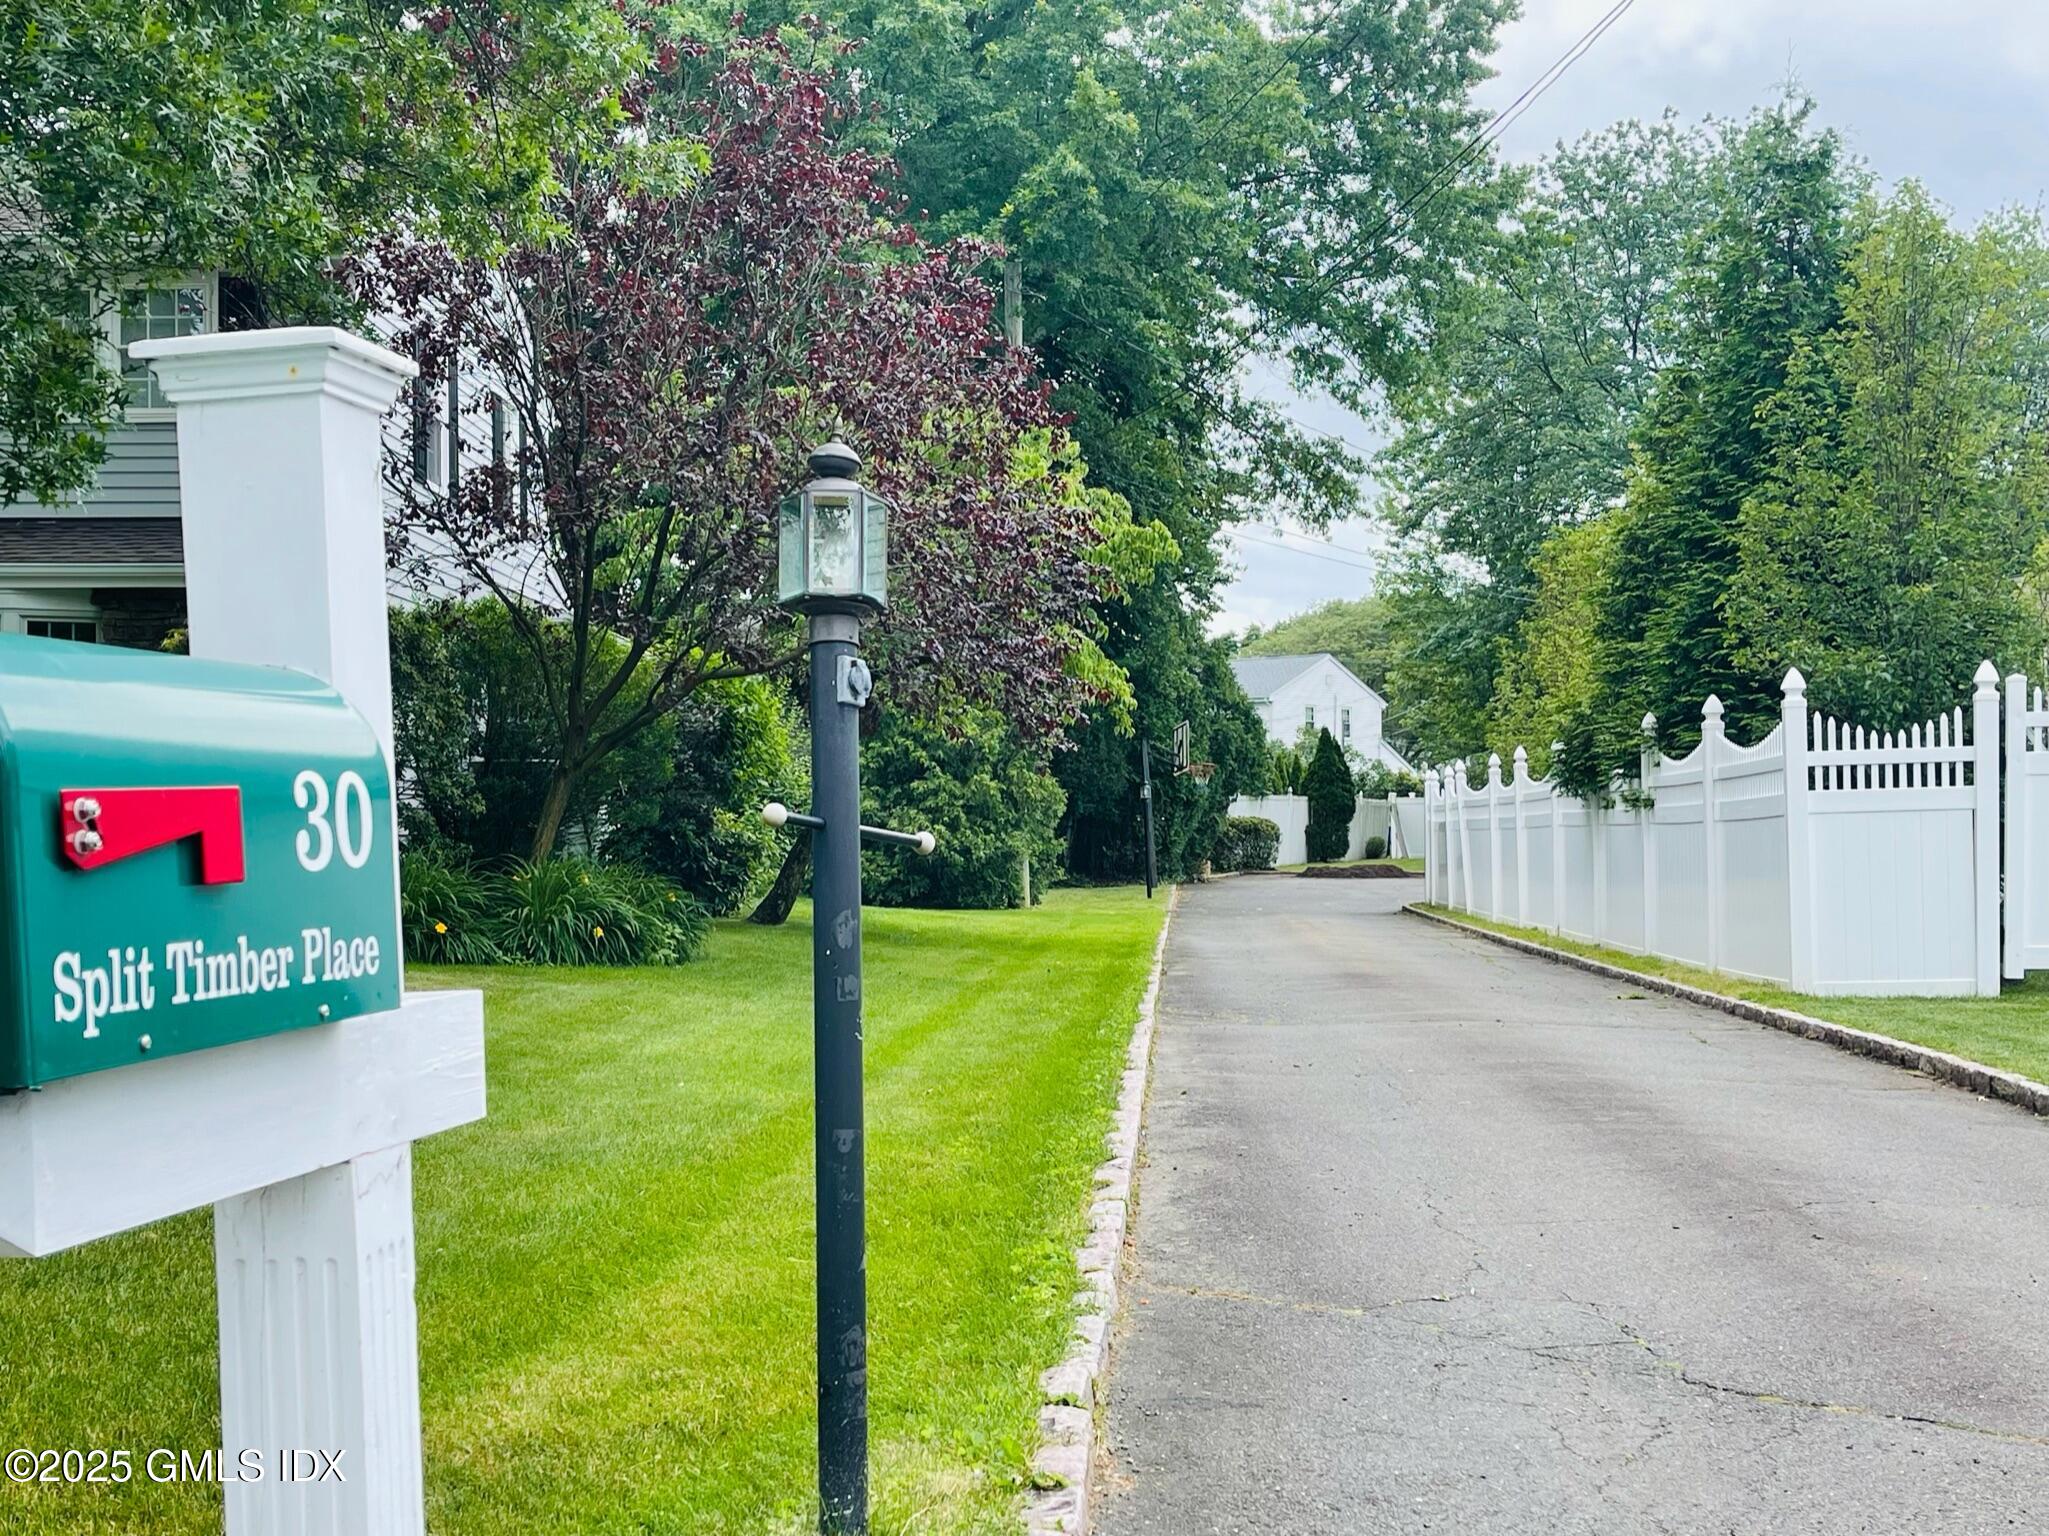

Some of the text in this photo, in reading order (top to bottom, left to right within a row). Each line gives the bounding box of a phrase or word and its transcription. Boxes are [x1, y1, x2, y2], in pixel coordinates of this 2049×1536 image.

[293, 770, 374, 872] 30
[53, 926, 380, 1039] Split Timber Place
